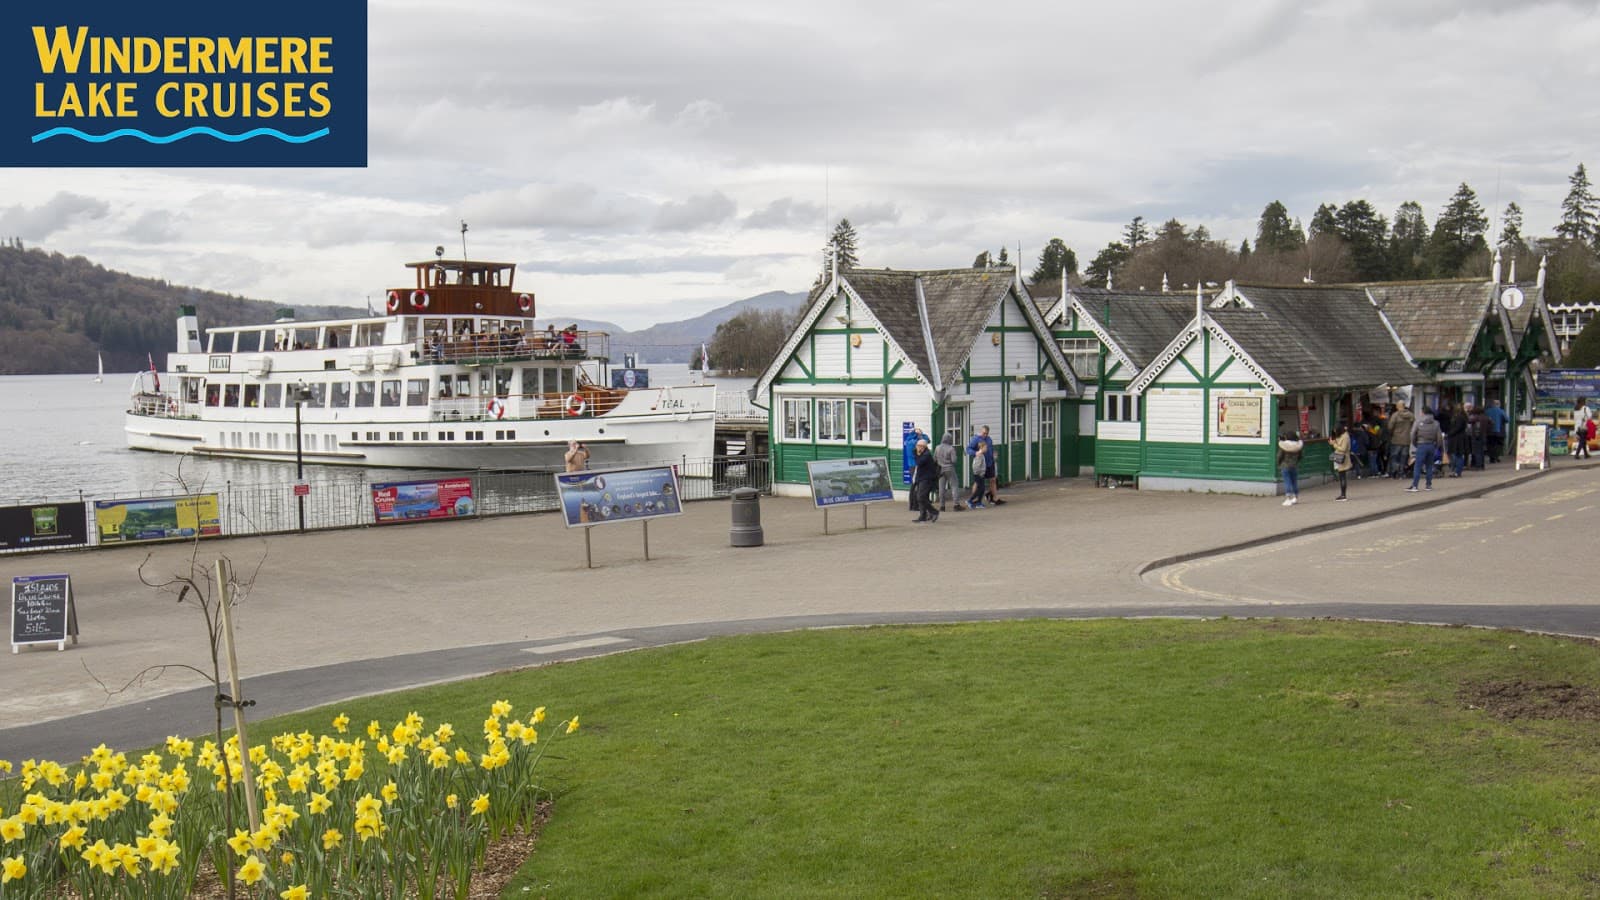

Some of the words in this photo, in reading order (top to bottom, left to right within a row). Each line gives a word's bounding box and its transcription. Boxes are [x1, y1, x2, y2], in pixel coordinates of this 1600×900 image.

[1507, 292, 1516, 308] 1
[211, 358, 228, 368] TEAL
[662, 399, 685, 408] TEAL
